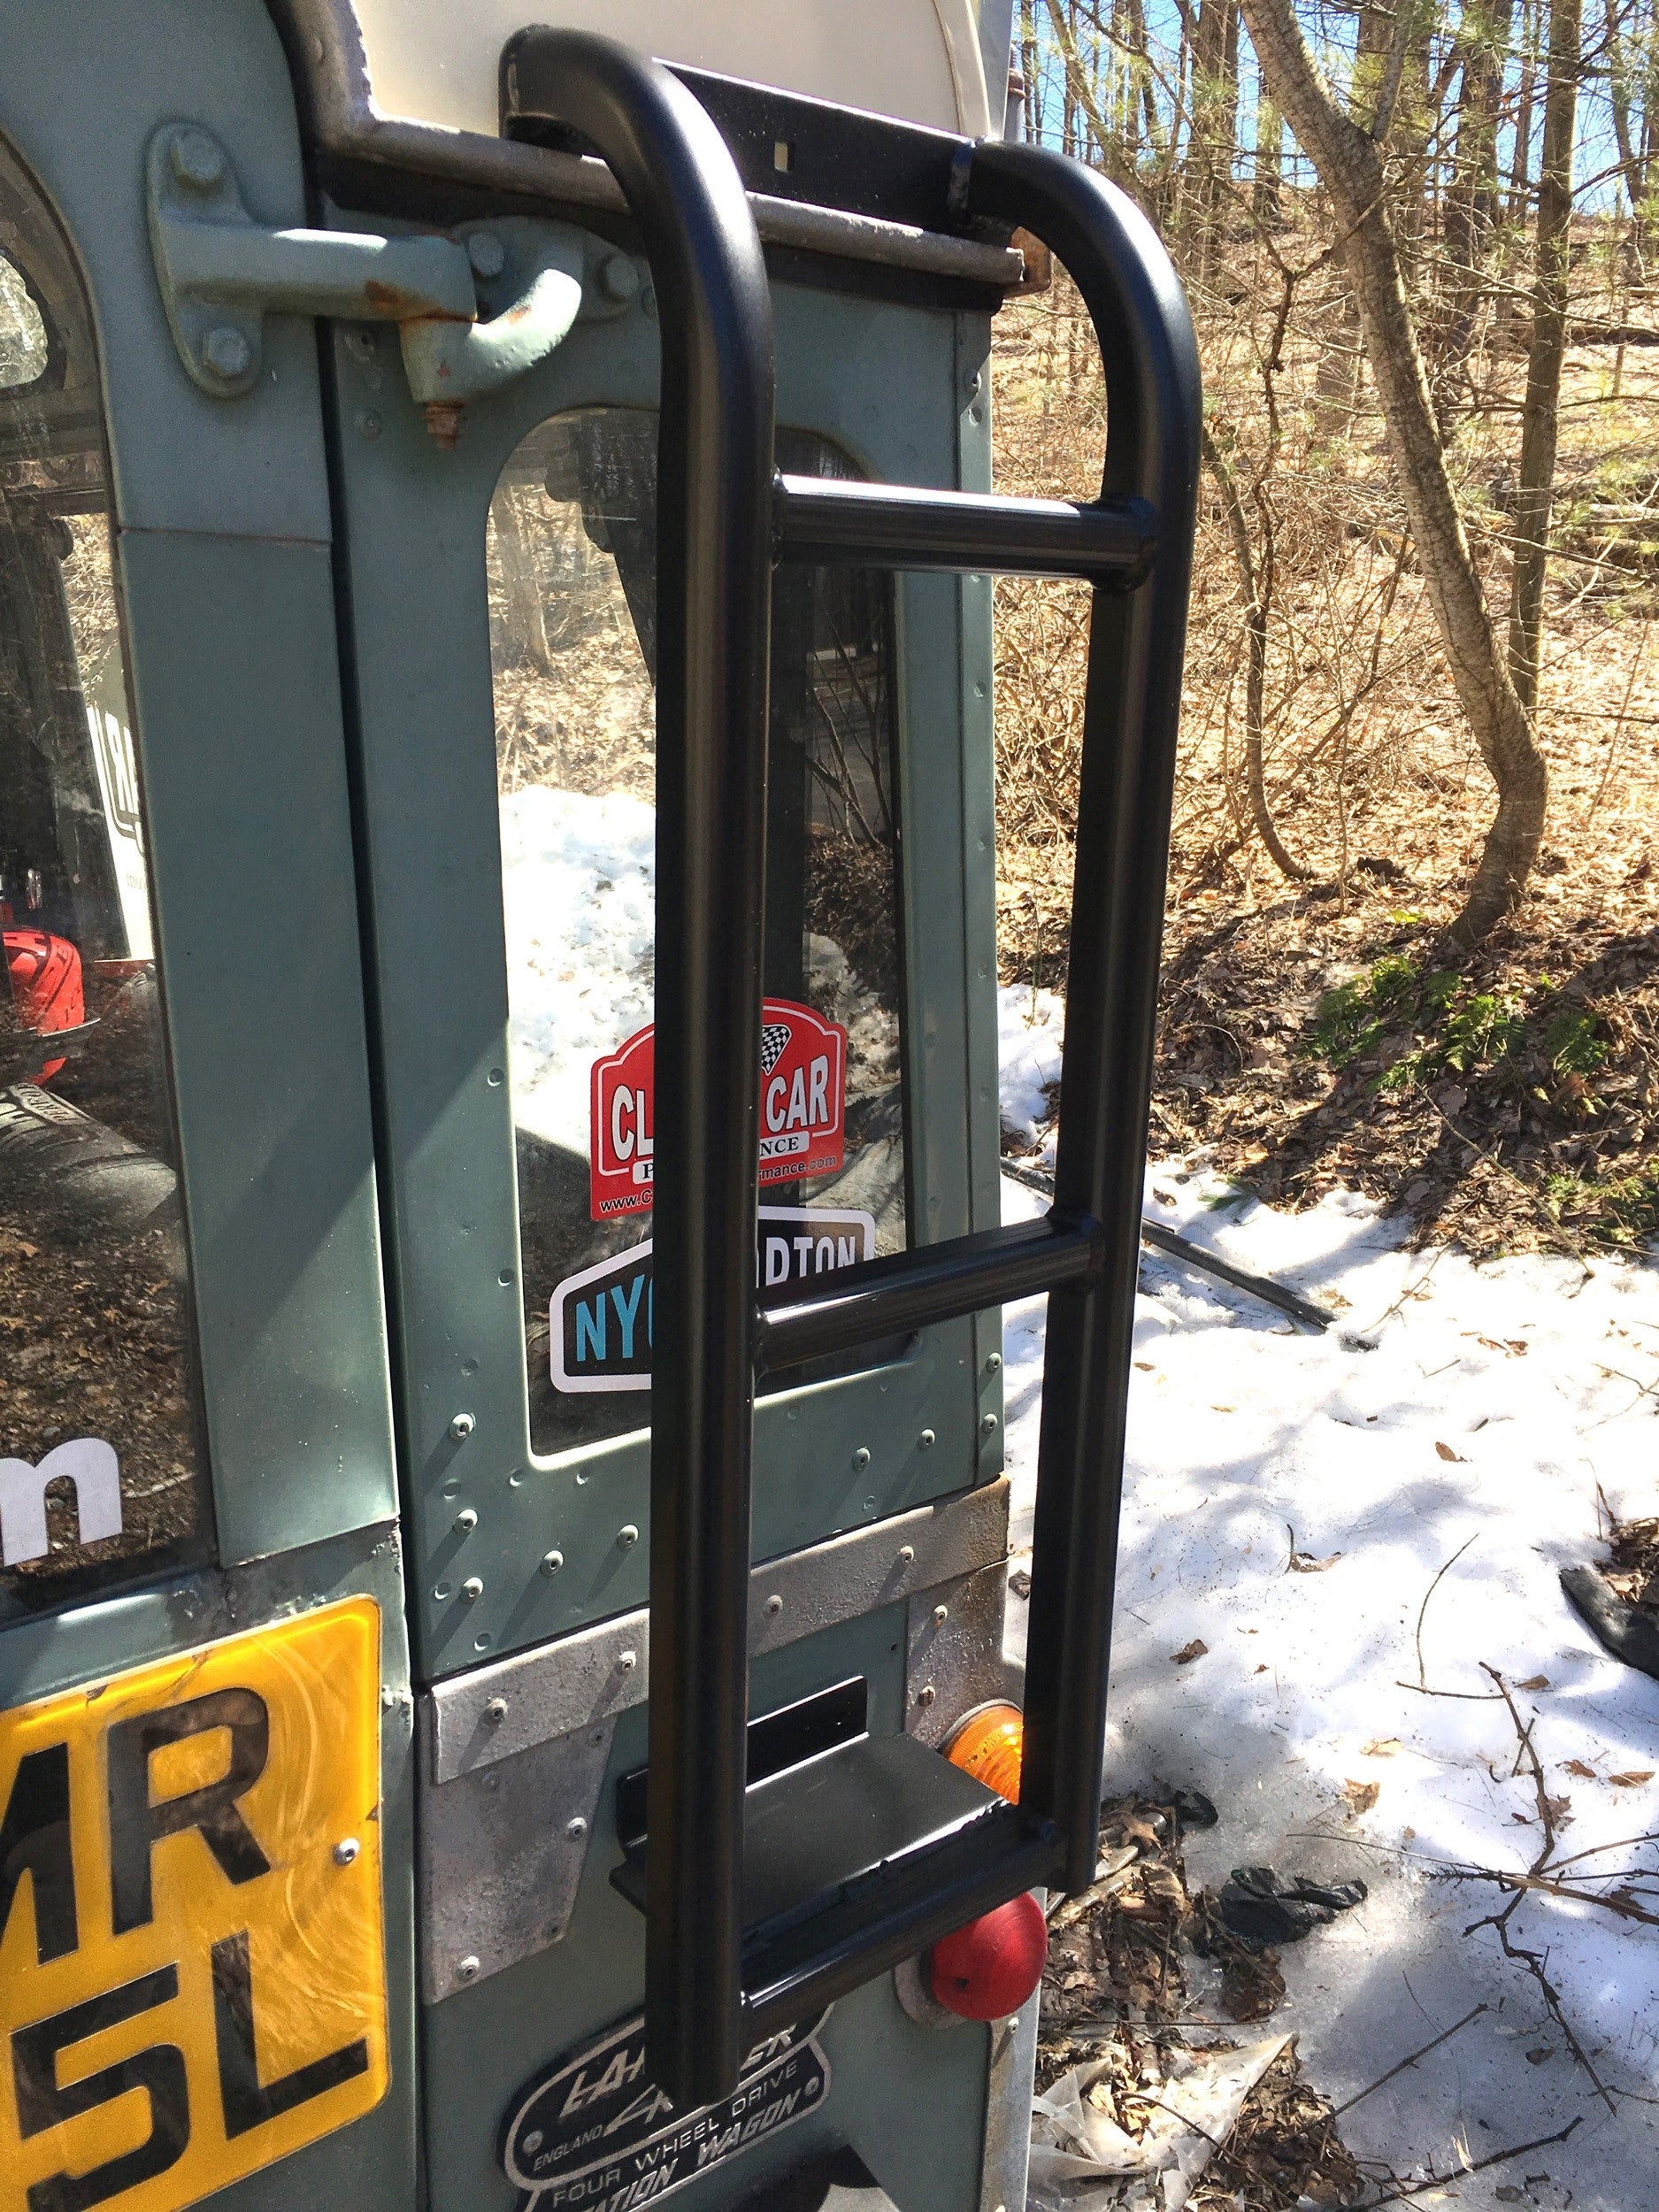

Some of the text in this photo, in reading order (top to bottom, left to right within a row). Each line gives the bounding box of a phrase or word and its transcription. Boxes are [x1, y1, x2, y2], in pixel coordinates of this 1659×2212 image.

[766, 1055, 829, 1133] CAR
[534, 2124, 603, 2171] ENGLAND
[553, 2060, 797, 2208] FOUR WHEEL DRIVE
[697, 2088, 802, 2167] WAGON
